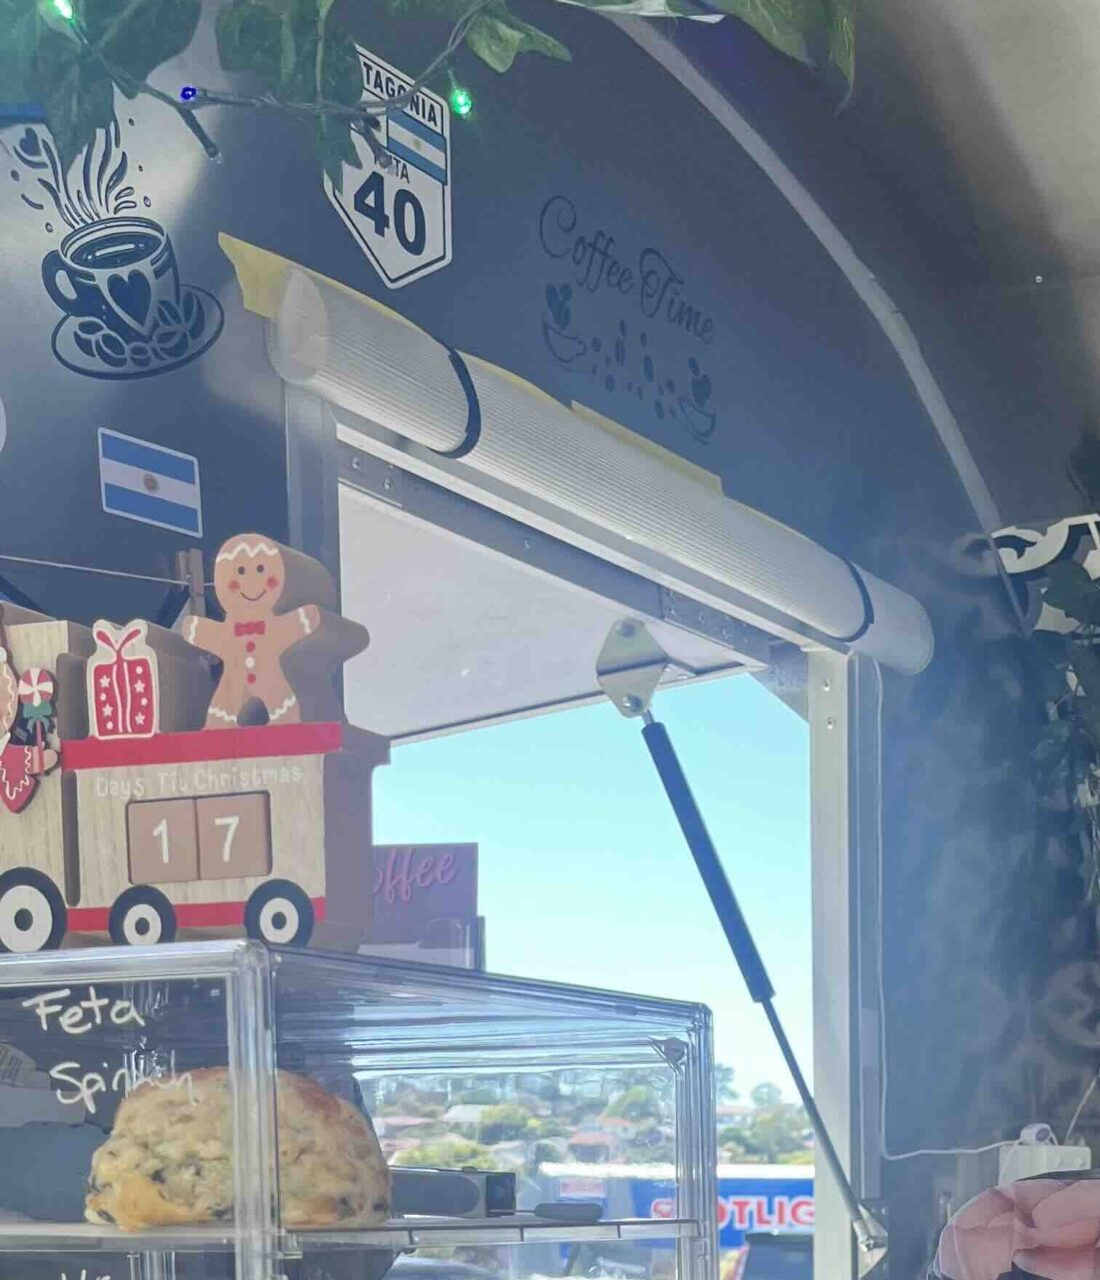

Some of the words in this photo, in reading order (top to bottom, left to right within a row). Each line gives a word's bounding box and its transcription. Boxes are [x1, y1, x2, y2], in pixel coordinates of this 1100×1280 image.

[354, 171, 426, 256] 40
[540, 195, 634, 294] Coffee
[640, 247, 715, 344] Time
[96, 776, 145, 800] Days
[194, 766, 303, 791] Christmas
[22, 985, 146, 1034] Feta
